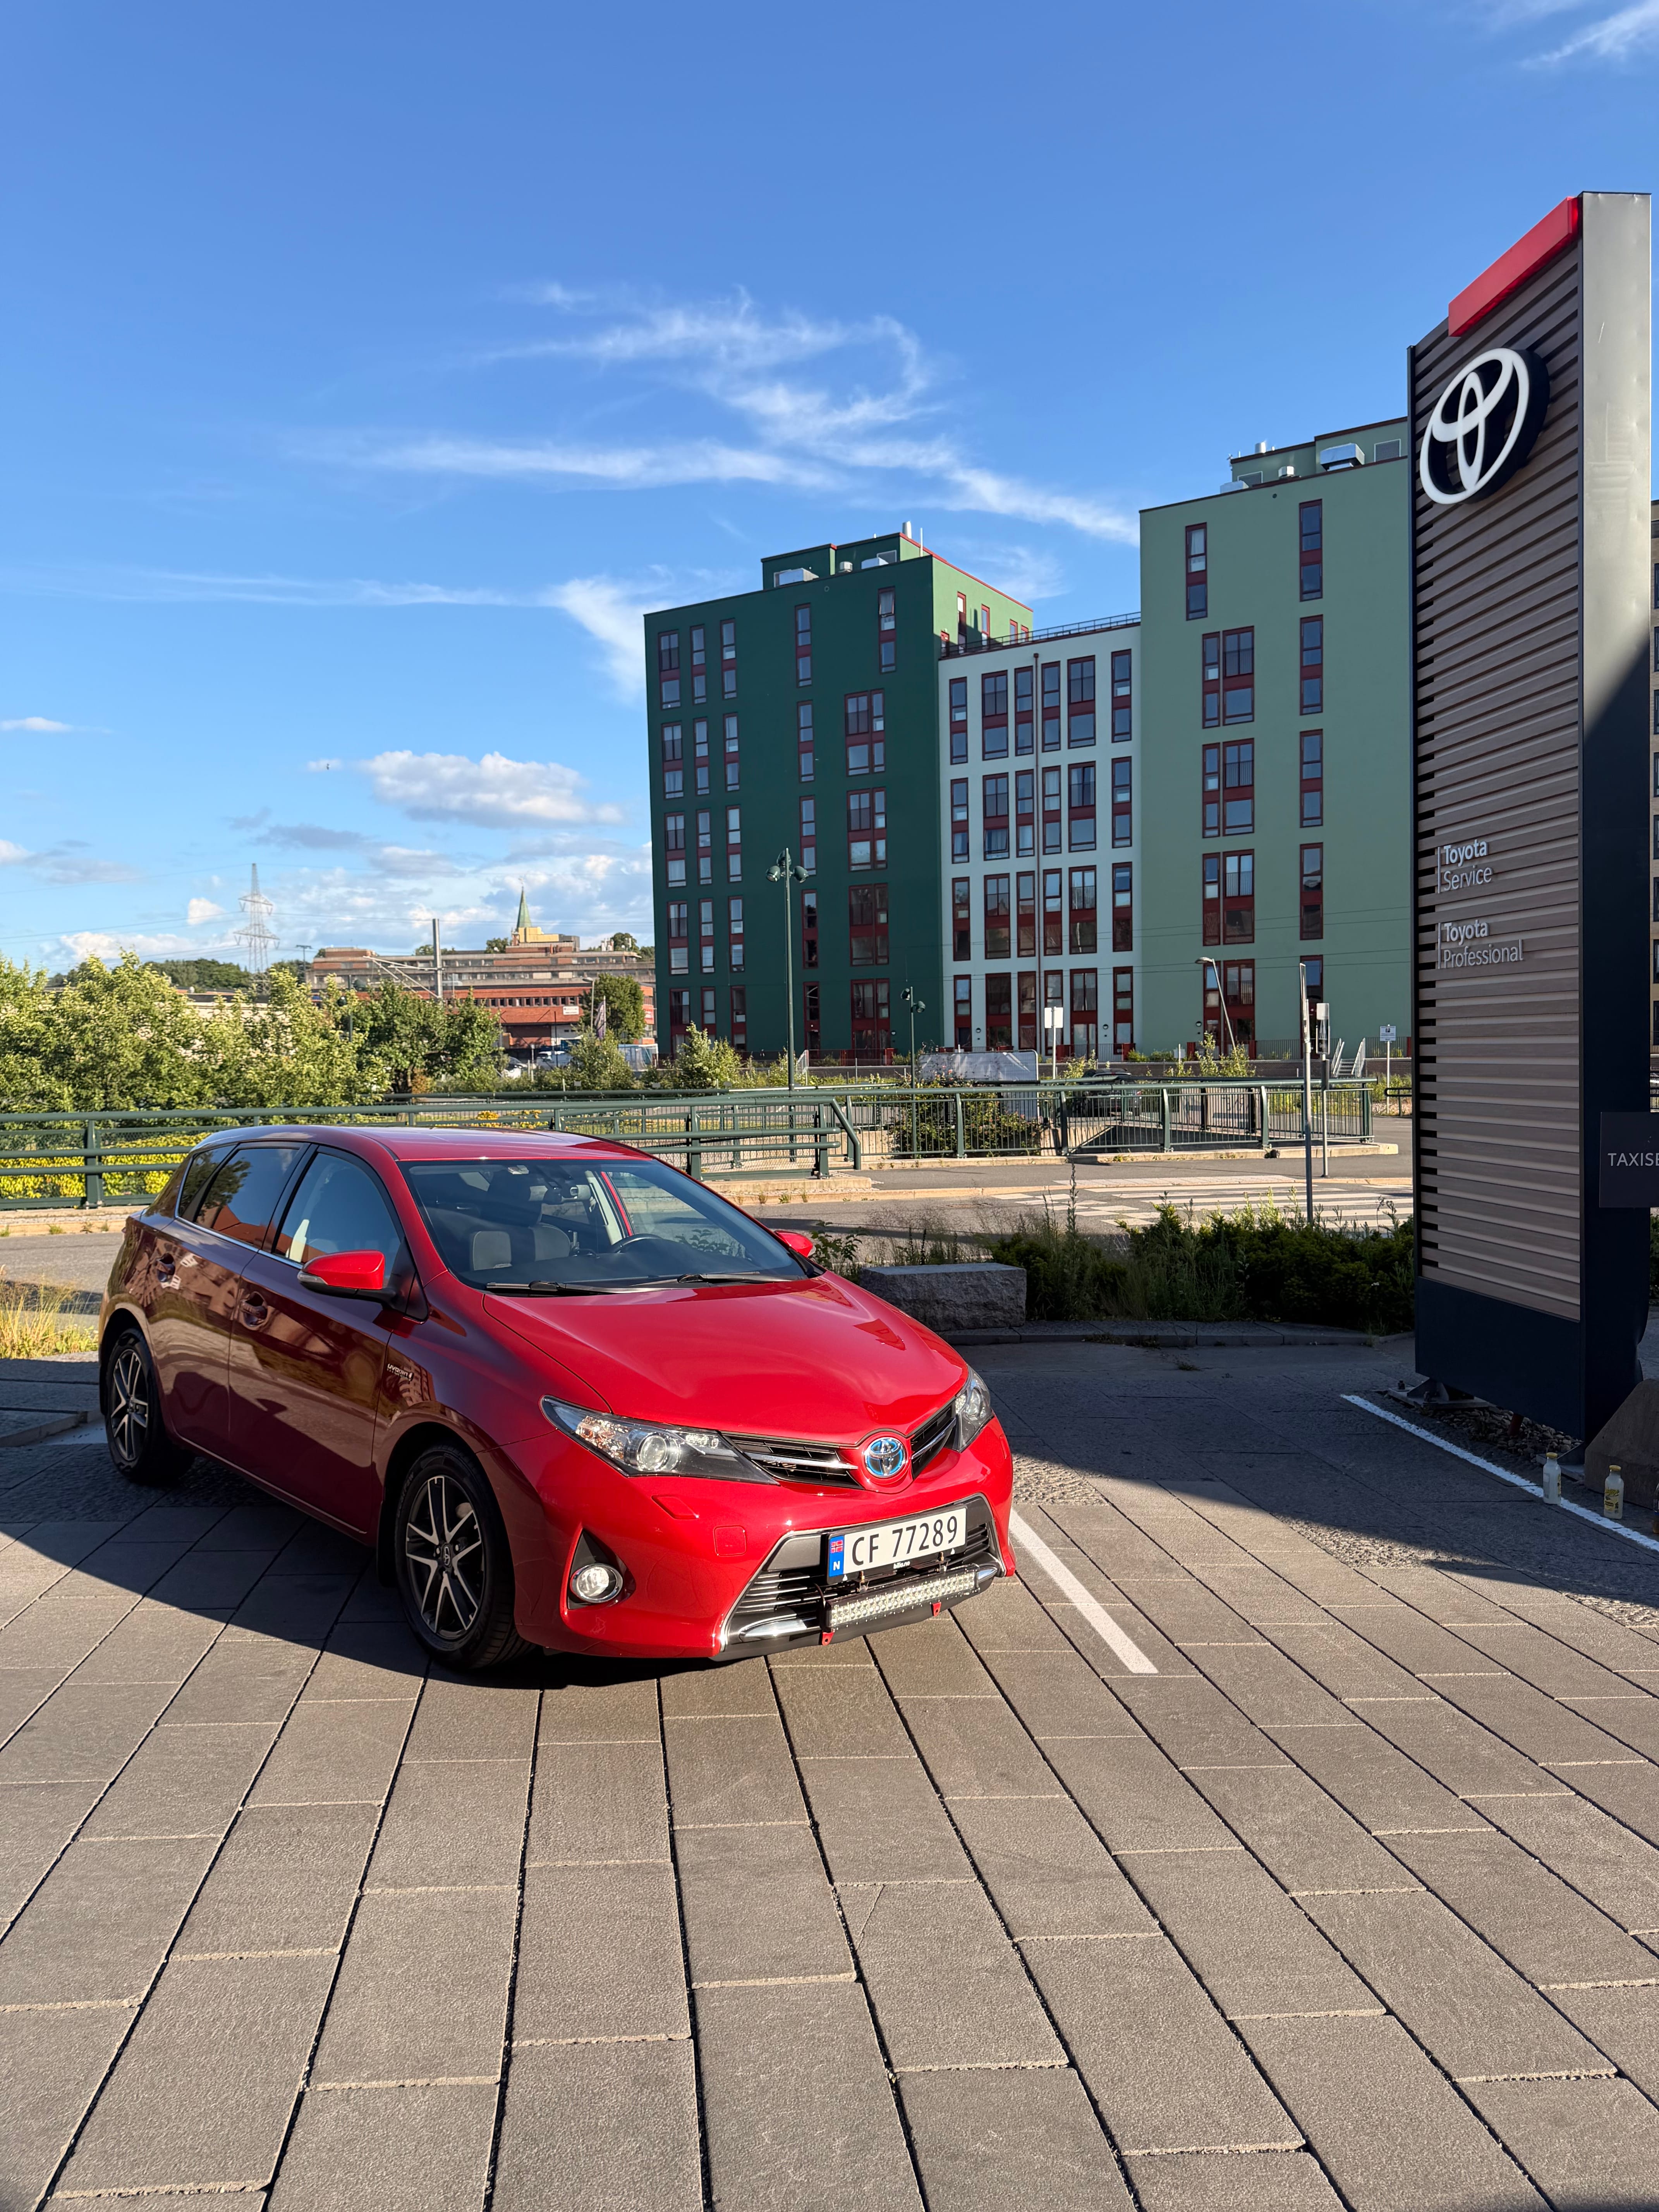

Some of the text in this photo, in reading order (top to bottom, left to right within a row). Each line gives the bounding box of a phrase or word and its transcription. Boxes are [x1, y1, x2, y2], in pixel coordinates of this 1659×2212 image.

[1444, 839, 1487, 867] Toyota
[1444, 866, 1492, 891] Service
[1444, 920, 1489, 945] Toyota
[1444, 939, 1523, 968] Professional
[852, 1516, 957, 1566] CF 77289
[833, 1561, 840, 1570] N
